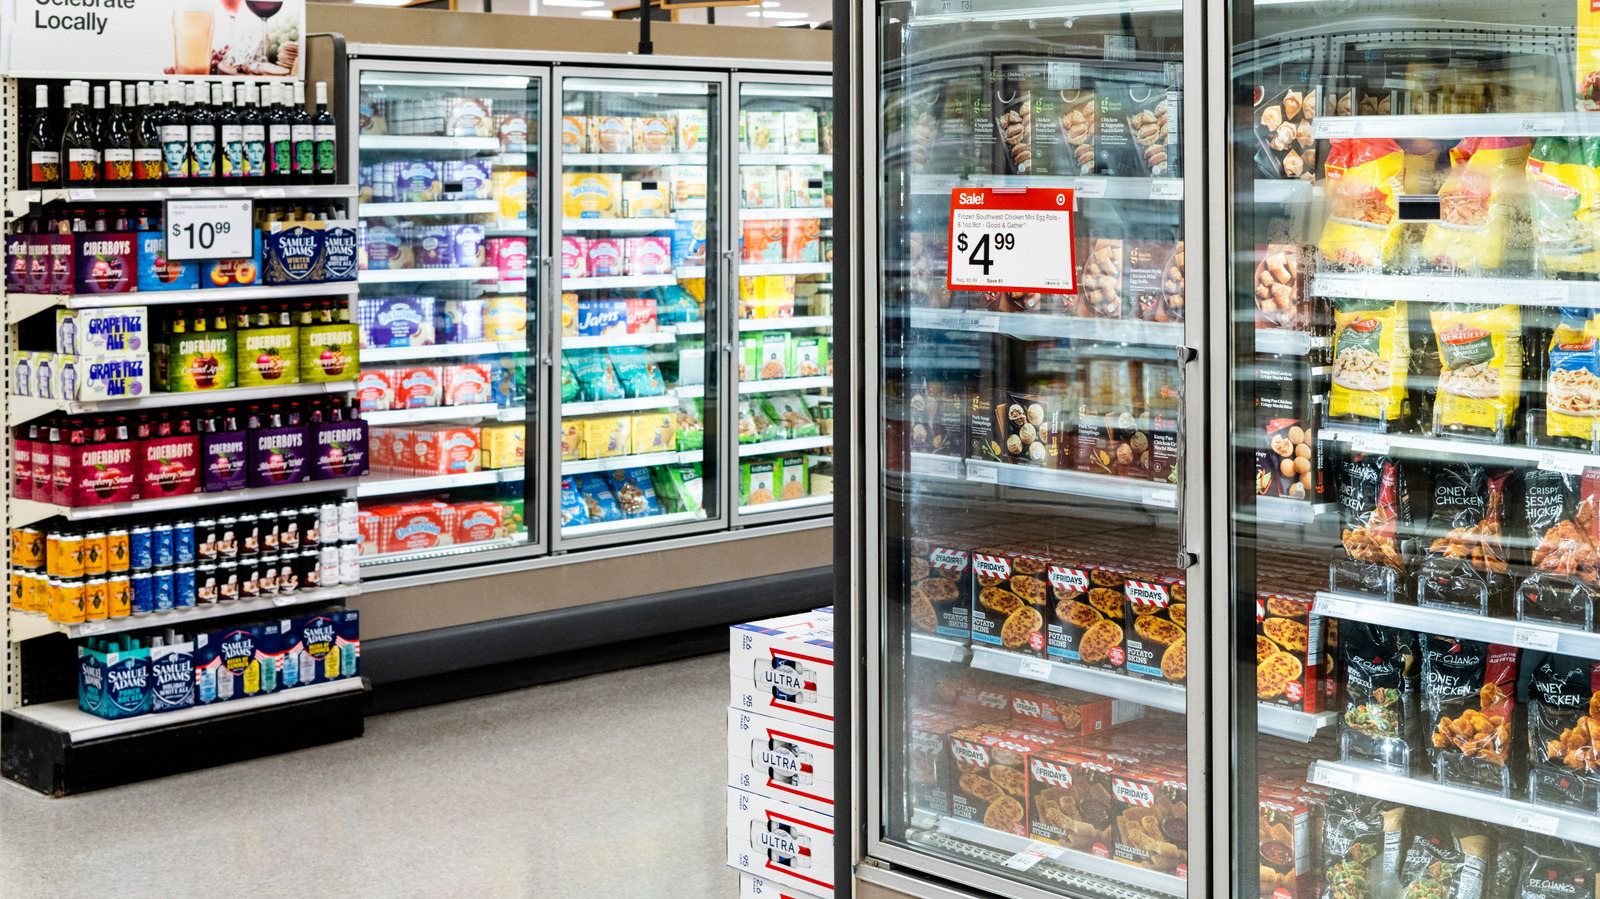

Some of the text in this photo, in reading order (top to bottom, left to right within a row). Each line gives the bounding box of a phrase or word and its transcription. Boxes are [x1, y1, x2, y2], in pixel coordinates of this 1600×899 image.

[35, 10, 108, 35] Locally
[959, 192, 984, 205] Sale!
[83, 241, 130, 256] CIDERBOYS
[279, 236, 317, 248] SAMUEL
[326, 236, 356, 248] SAMUEL
[282, 246, 314, 258] ADAMS
[326, 246, 353, 256] ADAMS
[579, 311, 619, 330] Jams
[628, 309, 650, 322] ams
[89, 316, 141, 334] GRAPE FIZZ
[107, 334, 124, 350] ALE
[247, 335, 291, 350] CIDERBOYS
[310, 331, 352, 347] CIDERBOYS
[1440, 332, 1484, 342] BERTOLLI
[179, 339, 227, 355] CIDERBOYS
[90, 361, 143, 379] GRAPE FIZZ
[107, 379, 125, 395] ALE
[258, 433, 302, 450] CIDERBOYS
[319, 428, 362, 444] CIDERBOYS
[148, 443, 193, 460] CIDERBOYS
[209, 442, 243, 454] CIDERBOYS
[82, 449, 131, 467] CIDERBOYS
[1435, 486, 1467, 497] ONEY
[1529, 486, 1559, 495] CRISPY
[1436, 496, 1484, 507] CHICKEN
[1525, 494, 1564, 507] SESAME
[980, 562, 1005, 572] FRIDAYS
[1057, 574, 1082, 585] FRIDAYS
[1134, 588, 1162, 600] FRIDAYS
[973, 617, 995, 627] POTATO
[304, 625, 335, 638] SAMUEL
[973, 625, 989, 633] SKINS
[307, 634, 332, 646] ADAMS
[1049, 632, 1072, 642] POTATO
[221, 639, 254, 653] SAMUEL
[1048, 640, 1066, 648] SKINS
[225, 649, 251, 660] ADAMS
[1128, 647, 1153, 659] POTATO
[1429, 651, 1442, 661] P.F.
[1128, 656, 1147, 664] SKINS
[82, 663, 103, 680] SAMUEL
[108, 666, 149, 683] SAMUEL
[153, 661, 193, 677] SAMUEL
[112, 677, 146, 692] ADAMS
[157, 671, 190, 686] ADAMS
[765, 671, 800, 689] ULTRA
[119, 688, 140, 696] PORCH
[1427, 684, 1471, 696] CHICKEN
[746, 694, 752, 707] 95
[958, 747, 984, 761] FRIDAYS
[762, 752, 797, 771] ULTRA
[744, 774, 750, 787] 95
[1039, 770, 1067, 782] FRIDAYS
[1121, 787, 1148, 800] FRIDAYS
[954, 802, 977, 814] POTATO
[954, 810, 972, 819] SKINS
[1032, 820, 1067, 836] MOZZARELLA
[1032, 829, 1050, 838] STICKS
[761, 833, 795, 854] ULTRA
[1115, 842, 1149, 858] MOZZARELLA
[743, 854, 749, 867] 95
[1115, 851, 1134, 860] STICKS
[1529, 879, 1541, 887] P.F.
